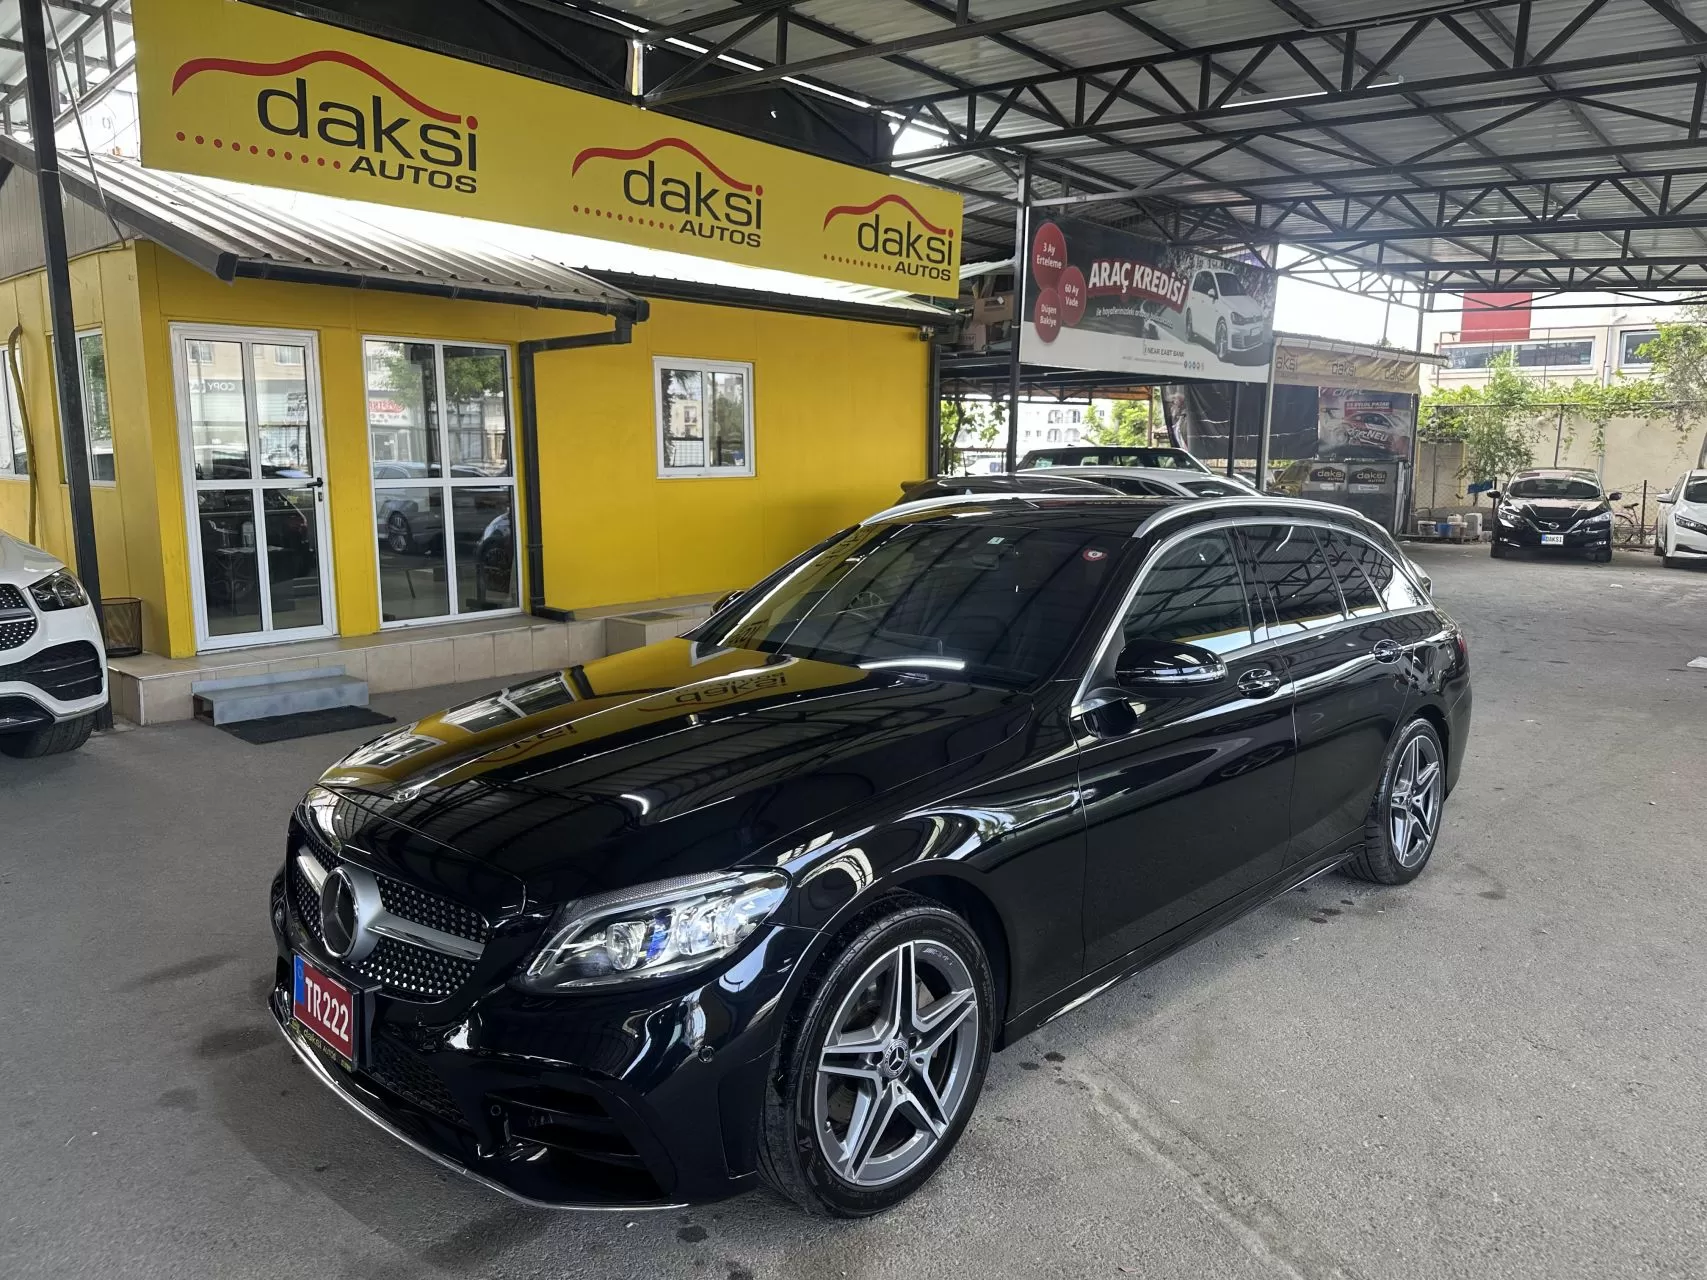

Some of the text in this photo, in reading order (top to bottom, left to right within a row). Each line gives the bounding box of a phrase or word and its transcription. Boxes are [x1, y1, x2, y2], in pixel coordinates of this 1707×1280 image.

[257, 77, 479, 172] daksi
[348, 155, 478, 194] AUTOS
[623, 160, 764, 231] daksi
[678, 219, 761, 248] AUTOS
[857, 213, 954, 267] daksi
[1042, 242, 1056, 256] 3 Ay
[893, 261, 951, 282] AUTOS
[1036, 255, 1062, 270] Erteleme
[1064, 283, 1080, 296] 60 Ay
[1088, 262, 1187, 305] ARAÇ KREDİSİ
[1065, 296, 1079, 307] Vade
[1040, 316, 1057, 328] Bakiye
[1276, 353, 1298, 372] aksi
